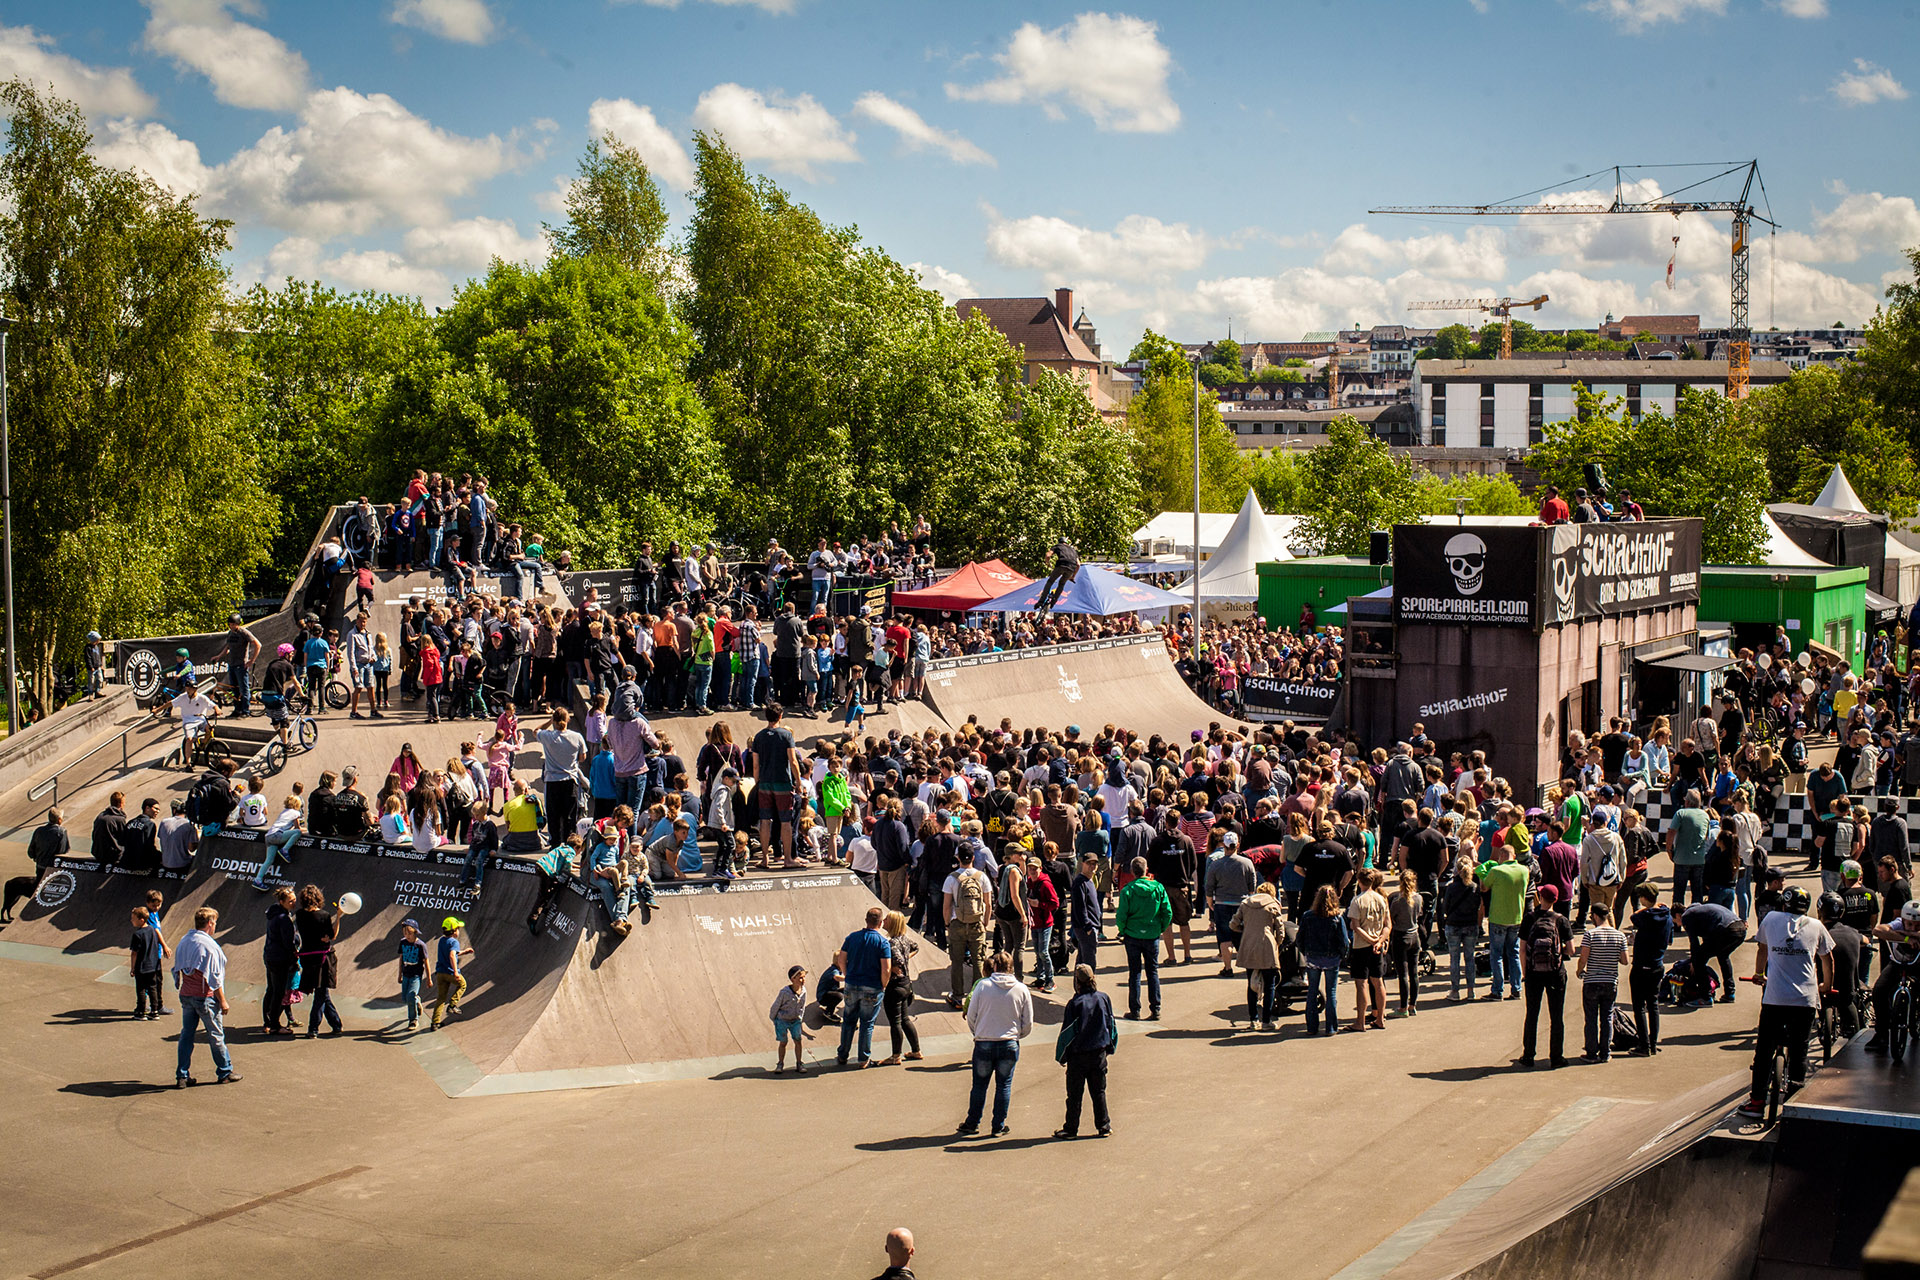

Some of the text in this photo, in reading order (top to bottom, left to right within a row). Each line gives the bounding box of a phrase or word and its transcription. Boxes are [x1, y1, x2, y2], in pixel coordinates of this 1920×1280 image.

[428, 584, 498, 594] stadwrke
[1401, 597, 1529, 616] SPORTPIRATEN.COM
[1401, 612, 1529, 623] WWW.FACEBOOK.COM/SCHLACHTHOF2001
[1245, 677, 1335, 700] #SCHLACHTHOF
[84, 711, 118, 735] VANS
[23, 741, 60, 768] VANS
[250, 805, 258, 815] 6
[225, 872, 237, 880] Plus
[394, 880, 434, 896] HOTEL
[395, 894, 472, 913] FLENSBURG
[730, 913, 793, 929] NAH.SH
